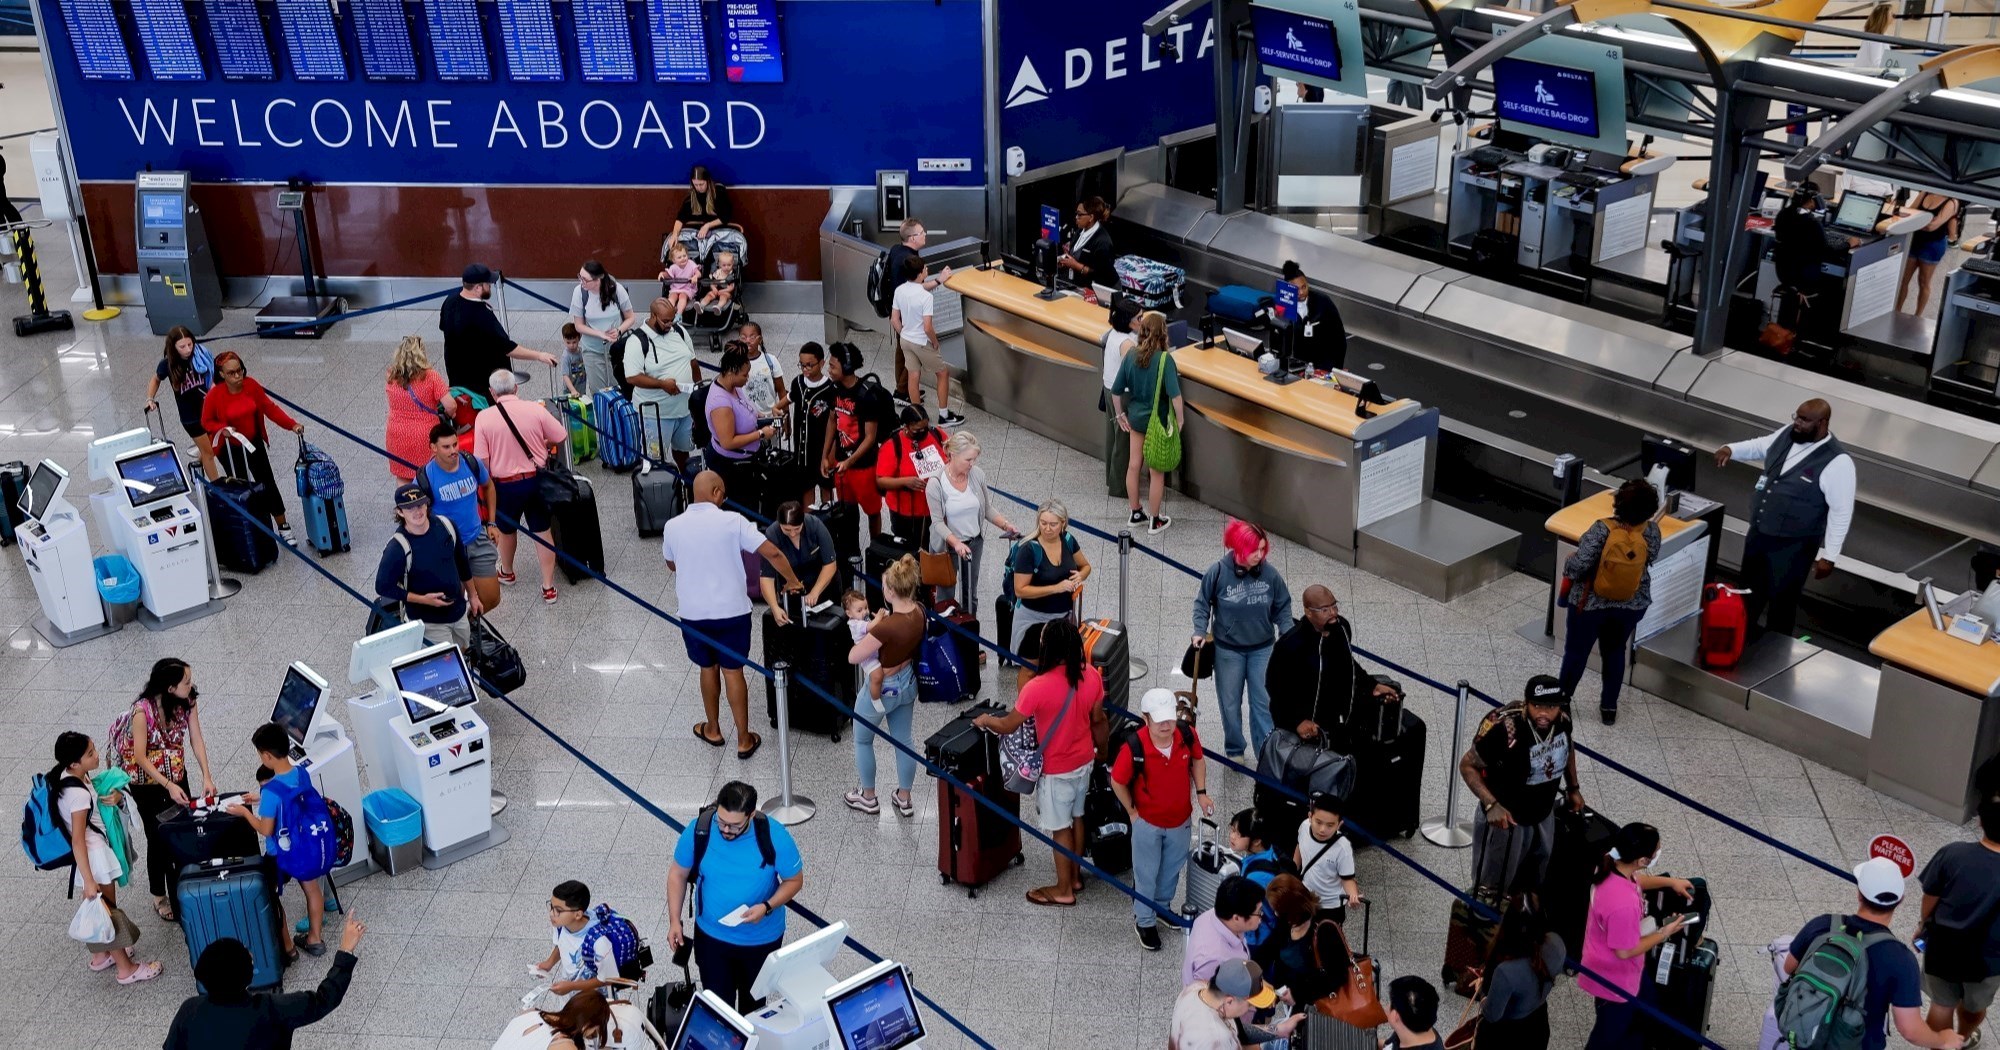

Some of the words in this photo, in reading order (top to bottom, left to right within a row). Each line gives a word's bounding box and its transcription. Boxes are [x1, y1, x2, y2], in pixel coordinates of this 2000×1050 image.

[1344, 1, 1354, 11] 46
[1065, 18, 1214, 90] DELTA
[1261, 47, 1300, 62] SELF-SERVICE
[1301, 55, 1314, 65] BAG
[1314, 58, 1332, 68] DROP
[1605, 50, 1618, 60] 48
[1502, 100, 1550, 117] SELF-SERVICE
[1551, 110, 1567, 120] BAG
[1568, 114, 1589, 124] DROP
[118, 98, 457, 148] WELCOME
[487, 99, 765, 148] ABOARD
[439, 482, 461, 501] SETON
[1873, 843, 1893, 858] WAIT
[1892, 852, 1912, 867] HERE
[1881, 840, 1907, 856] PLEASE
